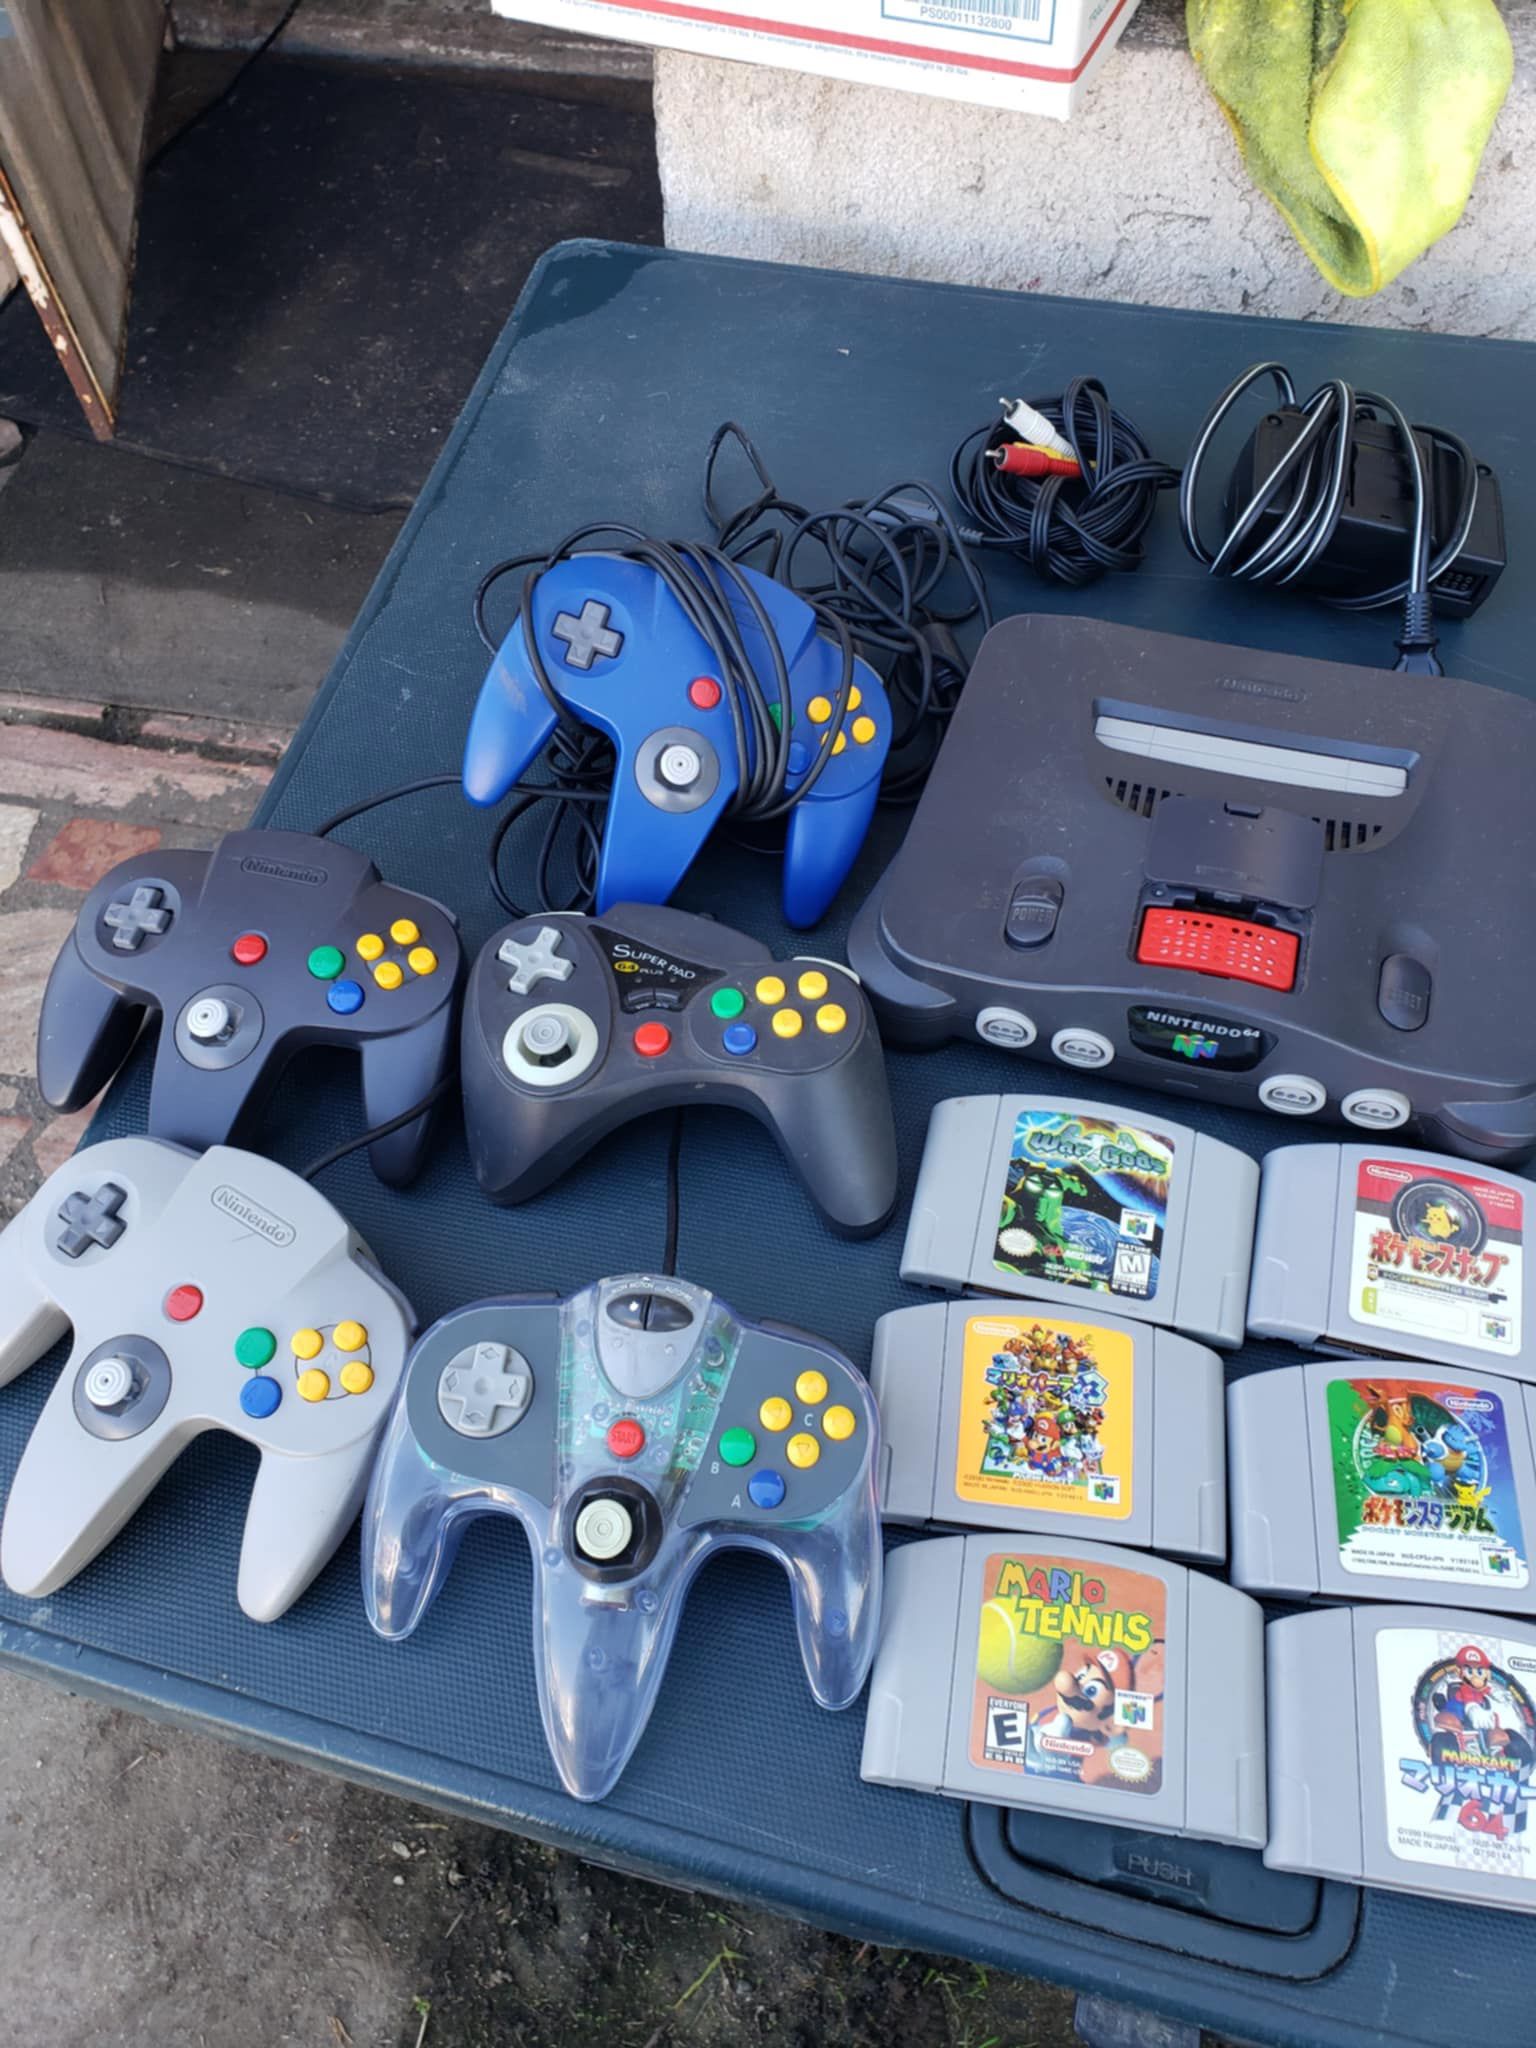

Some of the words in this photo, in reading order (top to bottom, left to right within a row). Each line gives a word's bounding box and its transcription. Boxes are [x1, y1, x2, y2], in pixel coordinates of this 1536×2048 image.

[919, 5, 1013, 32] PS00011132800
[246, 858, 319, 884] Nintendo
[612, 943, 669, 971] SUPER
[667, 963, 697, 981] PAD
[217, 1190, 287, 1242] Nintendo
[1119, 1253, 1146, 1275] M
[803, 1413, 814, 1427] C
[610, 1425, 638, 1444] START
[710, 1462, 720, 1475] B
[730, 1495, 741, 1509] A
[997, 1559, 1107, 1607] MARIO
[1017, 1597, 1153, 1652] TENNIS
[993, 1712, 1023, 1747] E
[1045, 1738, 1092, 1755] Nintendo
[1456, 1798, 1510, 1842] 64
[1127, 1853, 1193, 1887] PUSH
